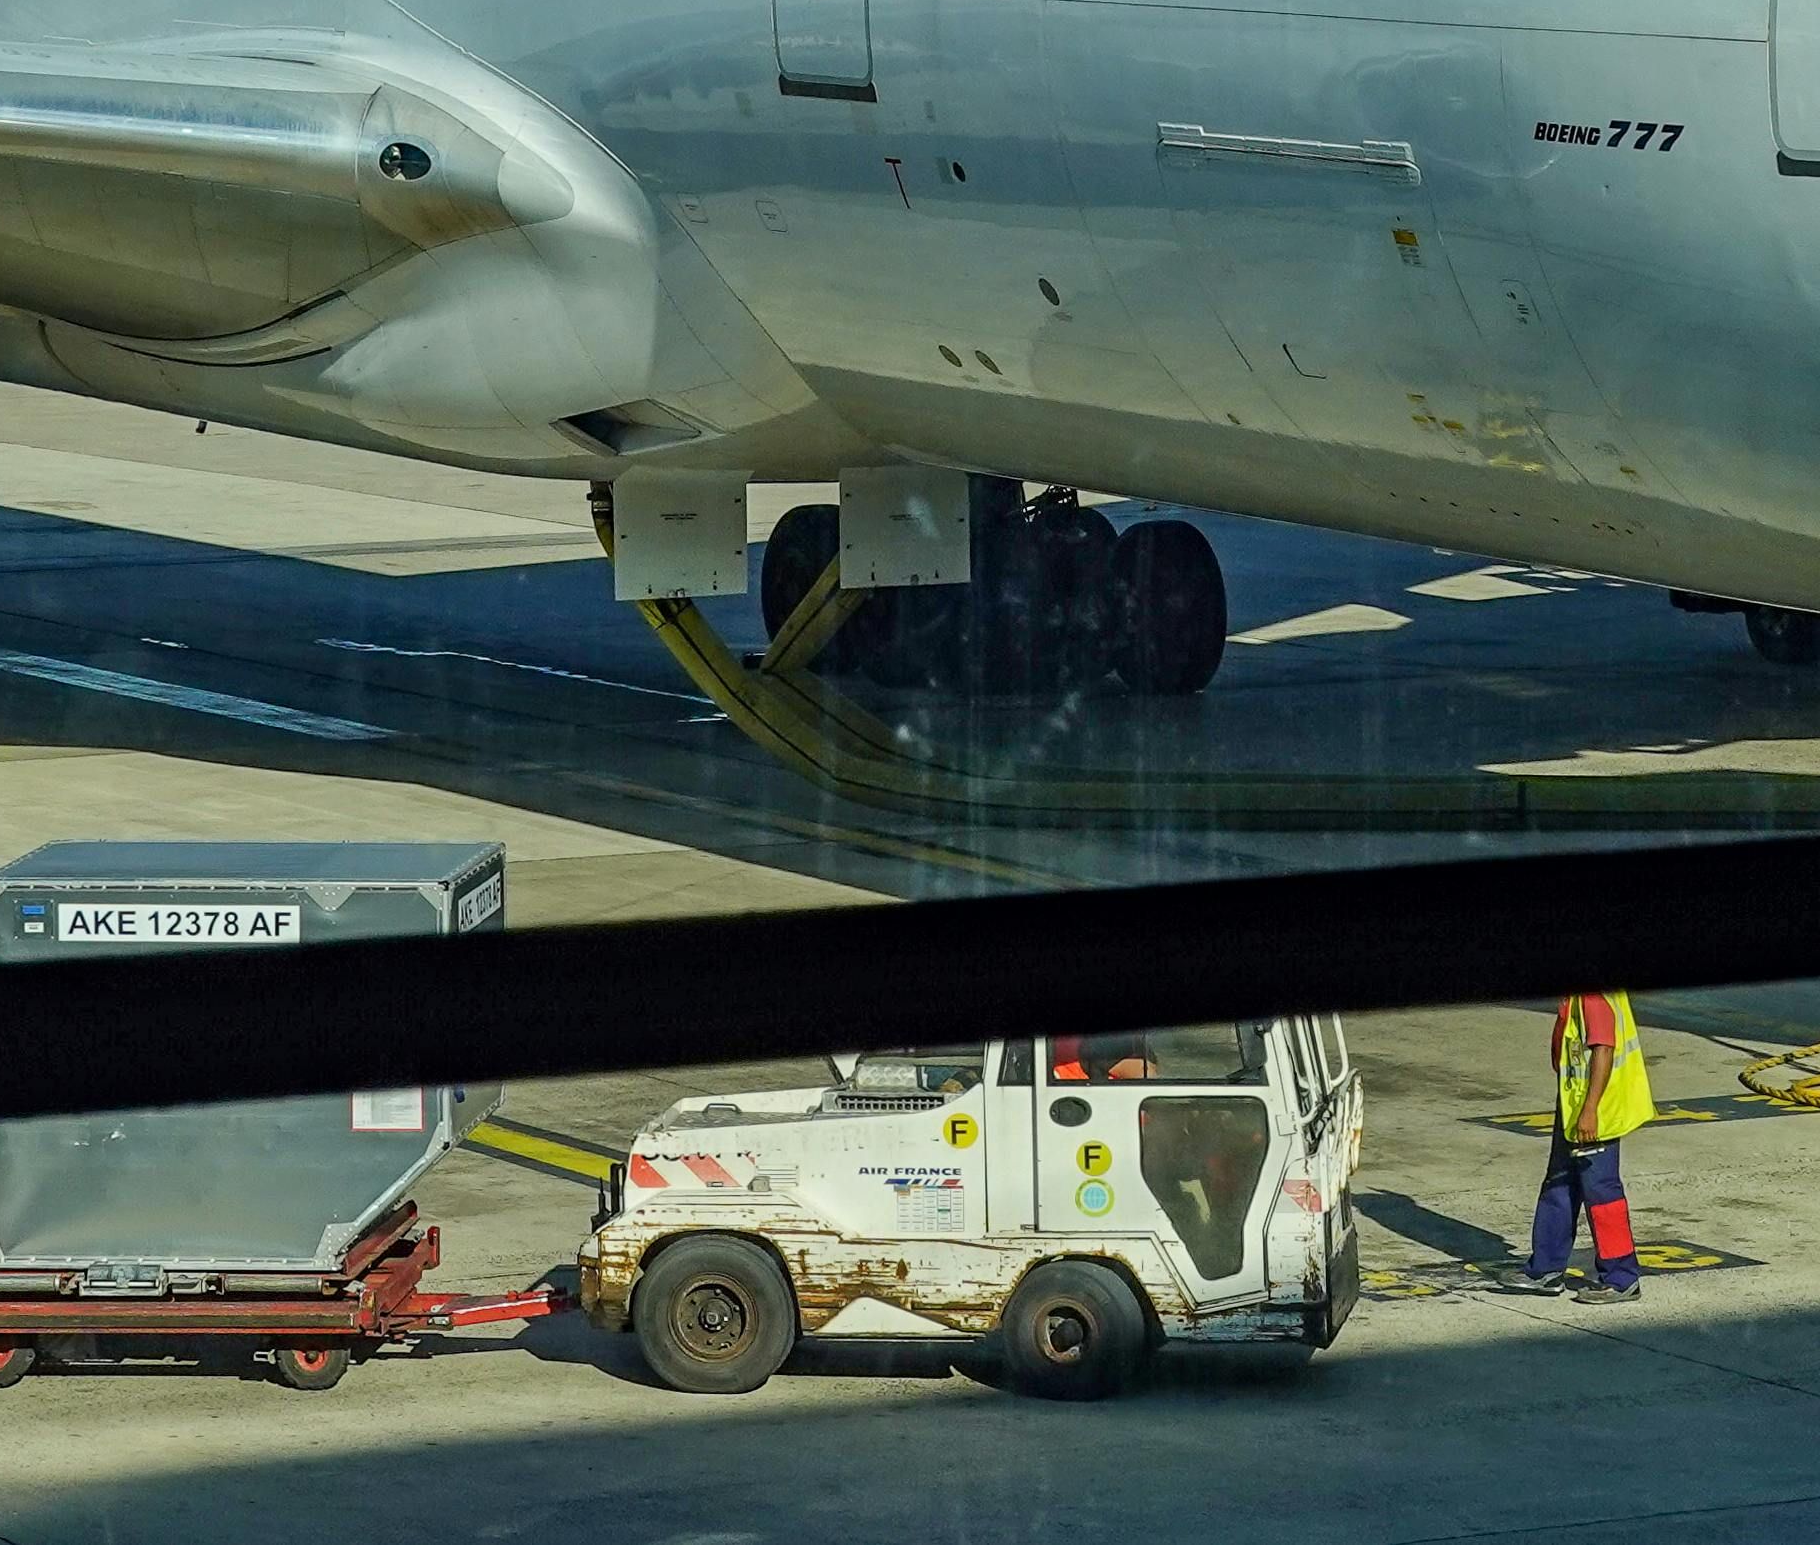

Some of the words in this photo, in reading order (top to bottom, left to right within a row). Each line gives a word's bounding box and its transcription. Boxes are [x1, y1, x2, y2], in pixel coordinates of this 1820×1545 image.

[1534, 122, 1601, 146] BOEING
[1606, 120, 1684, 152] 777
[68, 910, 137, 936] AKE
[147, 911, 240, 937] 12378
[249, 911, 292, 937] AF
[459, 898, 474, 931] AKE
[950, 1119, 969, 1145] F
[1083, 1144, 1102, 1170] F
[858, 1167, 888, 1176] AIR
[894, 1167, 962, 1177] FRANCE
